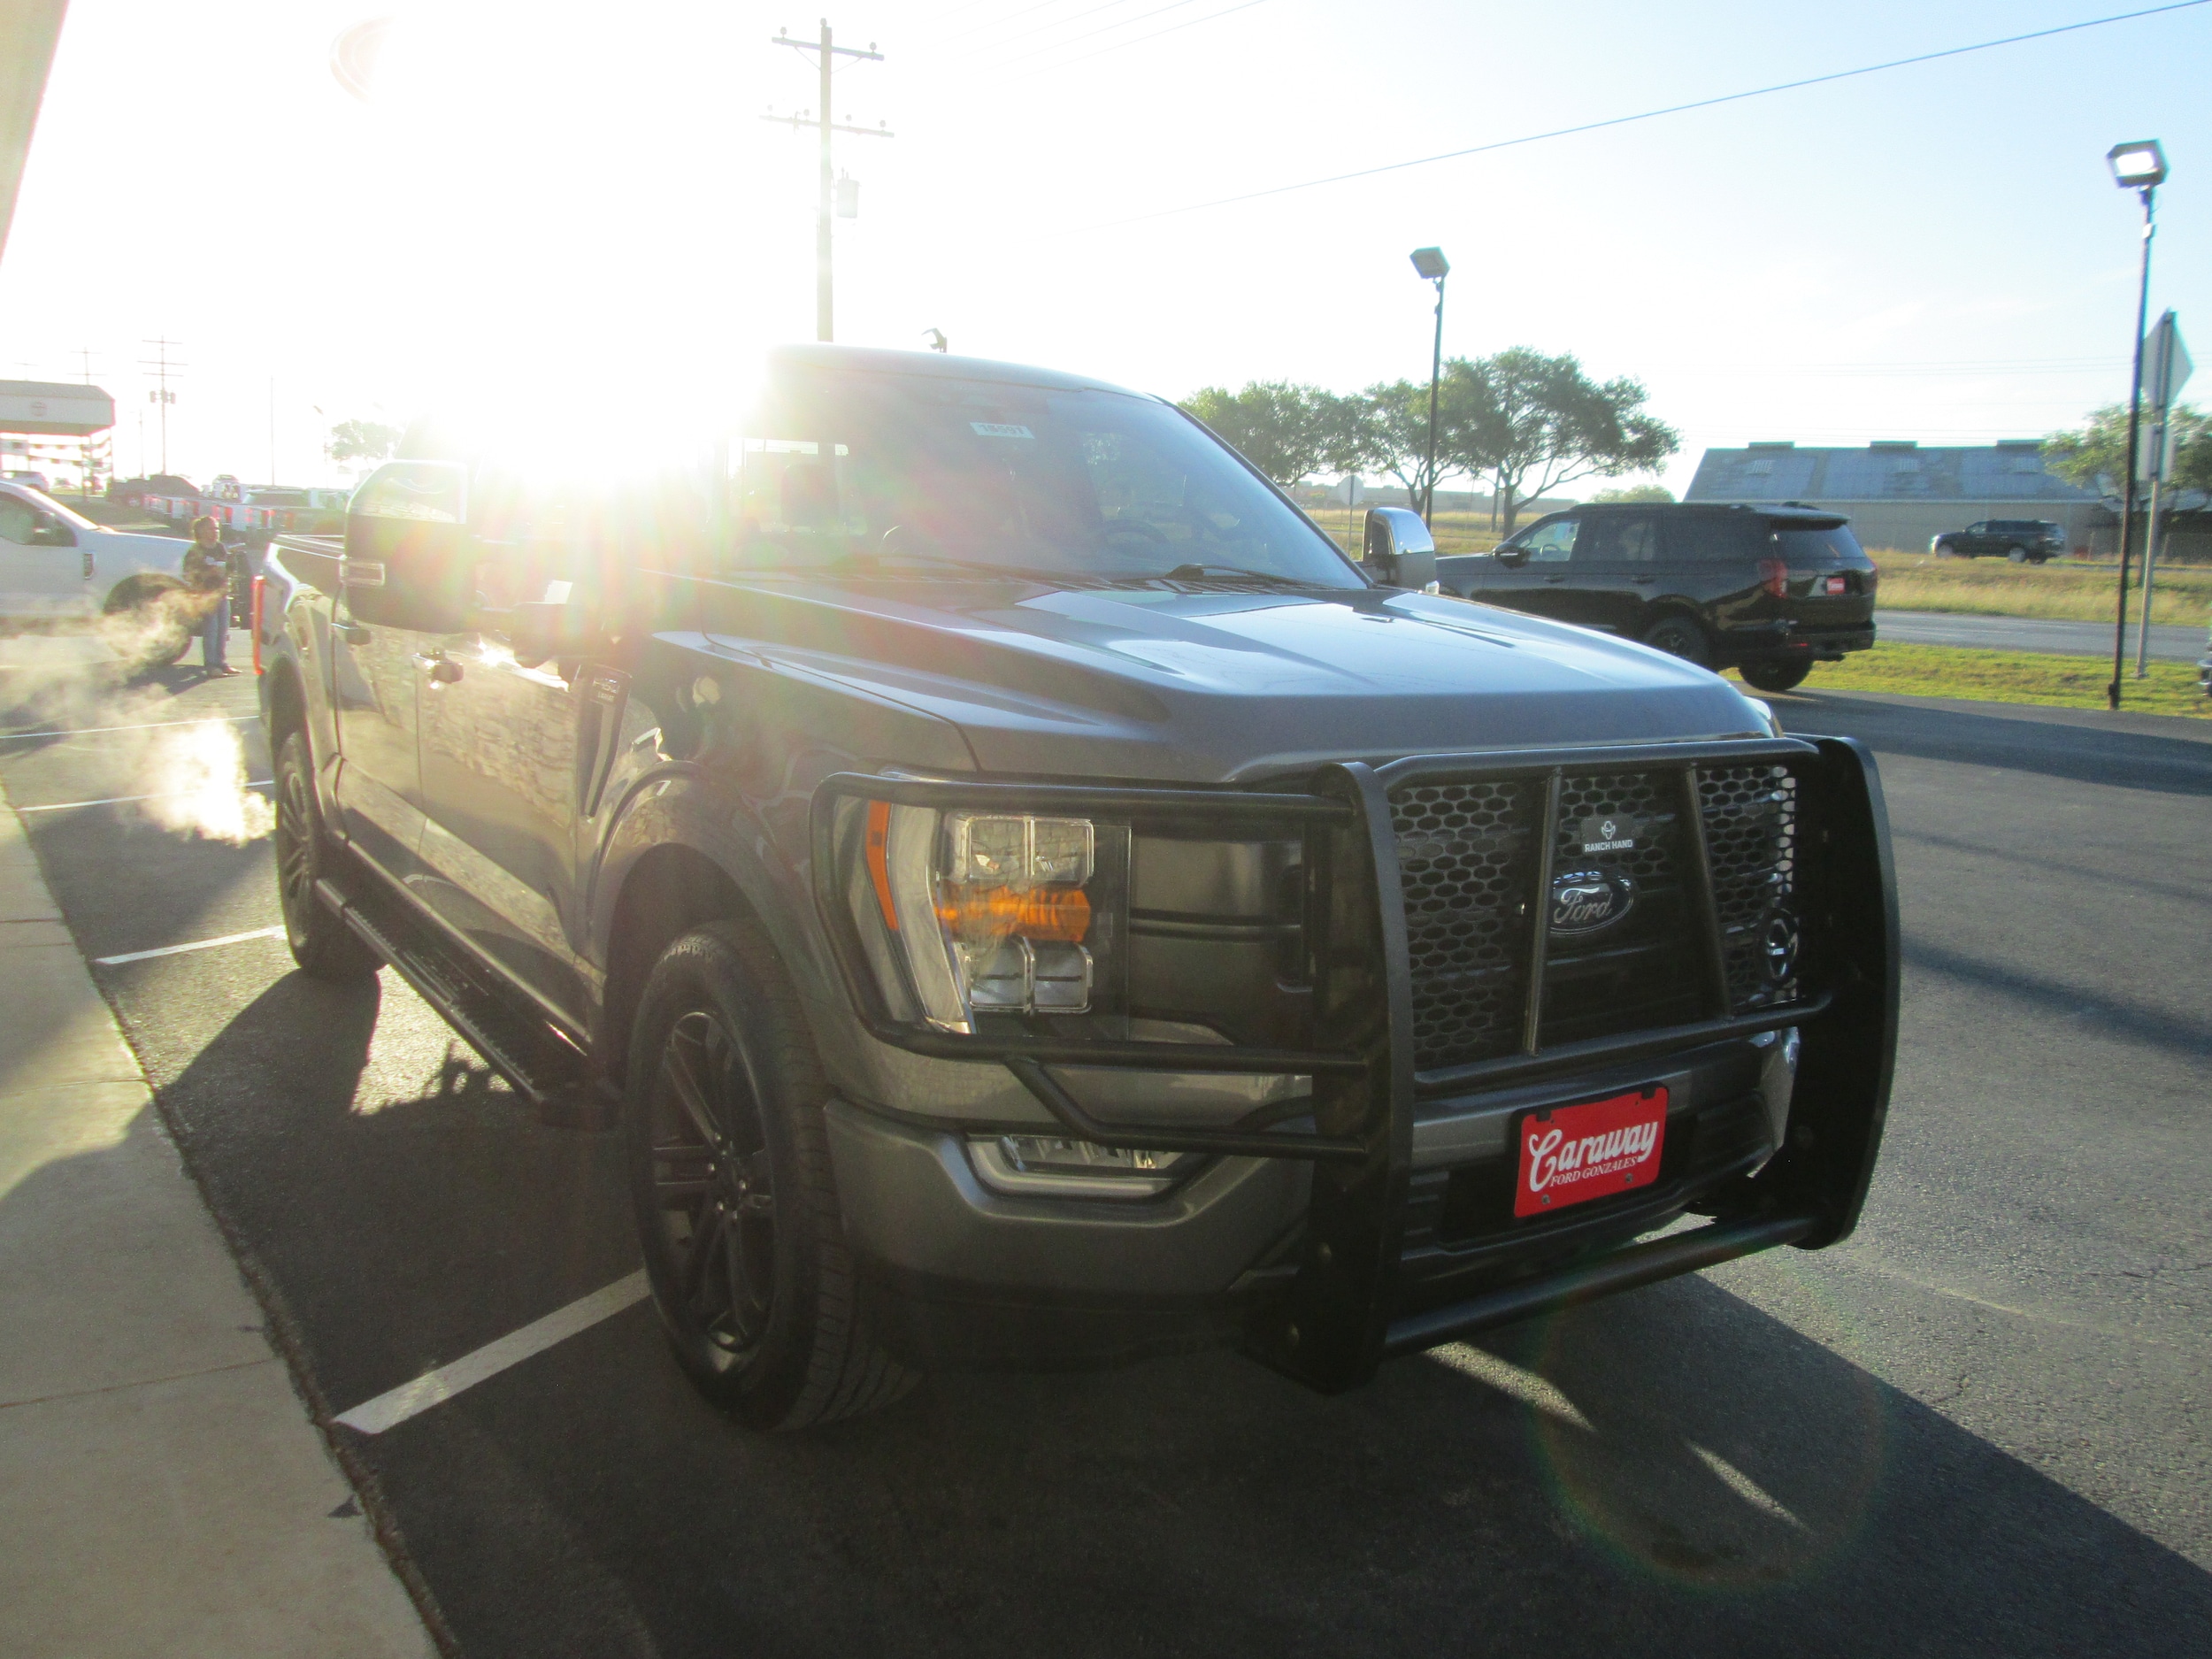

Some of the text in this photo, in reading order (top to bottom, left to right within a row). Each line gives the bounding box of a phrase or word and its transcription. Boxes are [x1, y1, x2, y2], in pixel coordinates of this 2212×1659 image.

[1585, 839, 1633, 852] RANCH HAND
[1553, 887, 1613, 924] Ford
[1528, 1121, 1659, 1193] Caraway
[1549, 1156, 1638, 1187] FORD GONZALES
